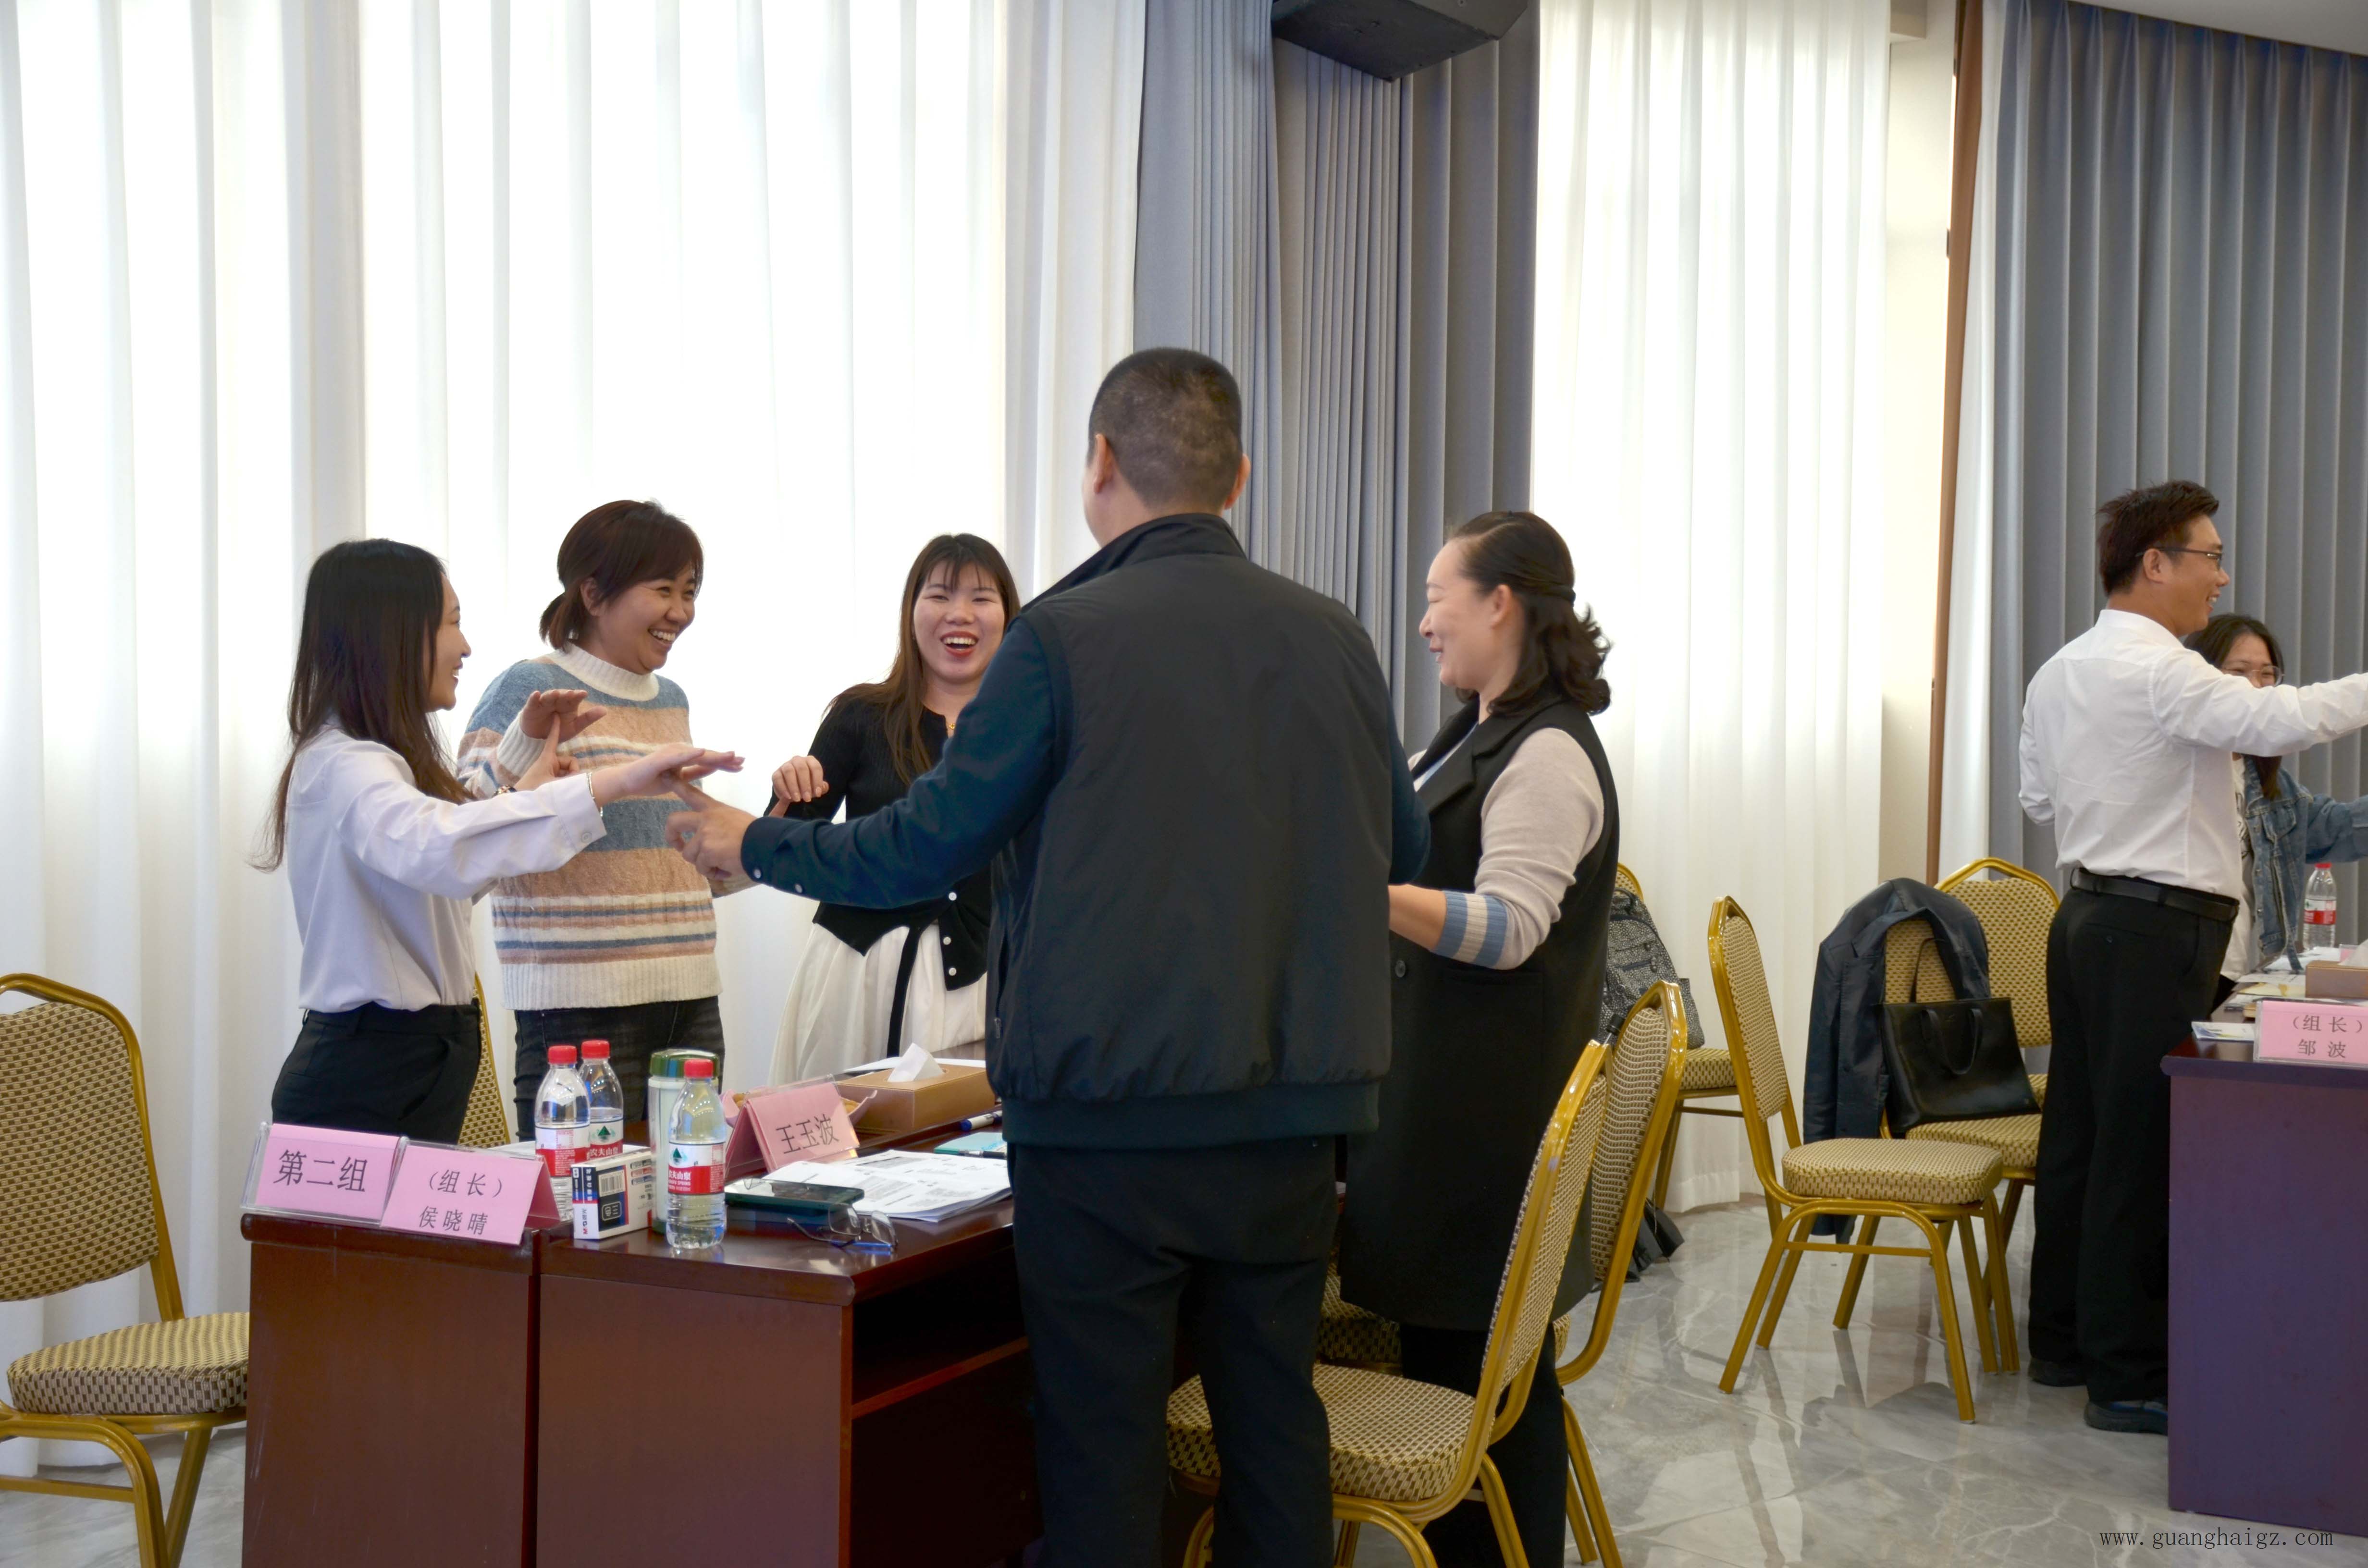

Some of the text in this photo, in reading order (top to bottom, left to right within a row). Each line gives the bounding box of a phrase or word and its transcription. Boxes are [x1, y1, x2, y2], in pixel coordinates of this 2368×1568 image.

[2298, 1039, 2346, 1058] 邹波
[776, 1114, 839, 1154] 王玉波
[273, 1149, 368, 1192] 第二组
[419, 1205, 488, 1235] 侯晓晴
